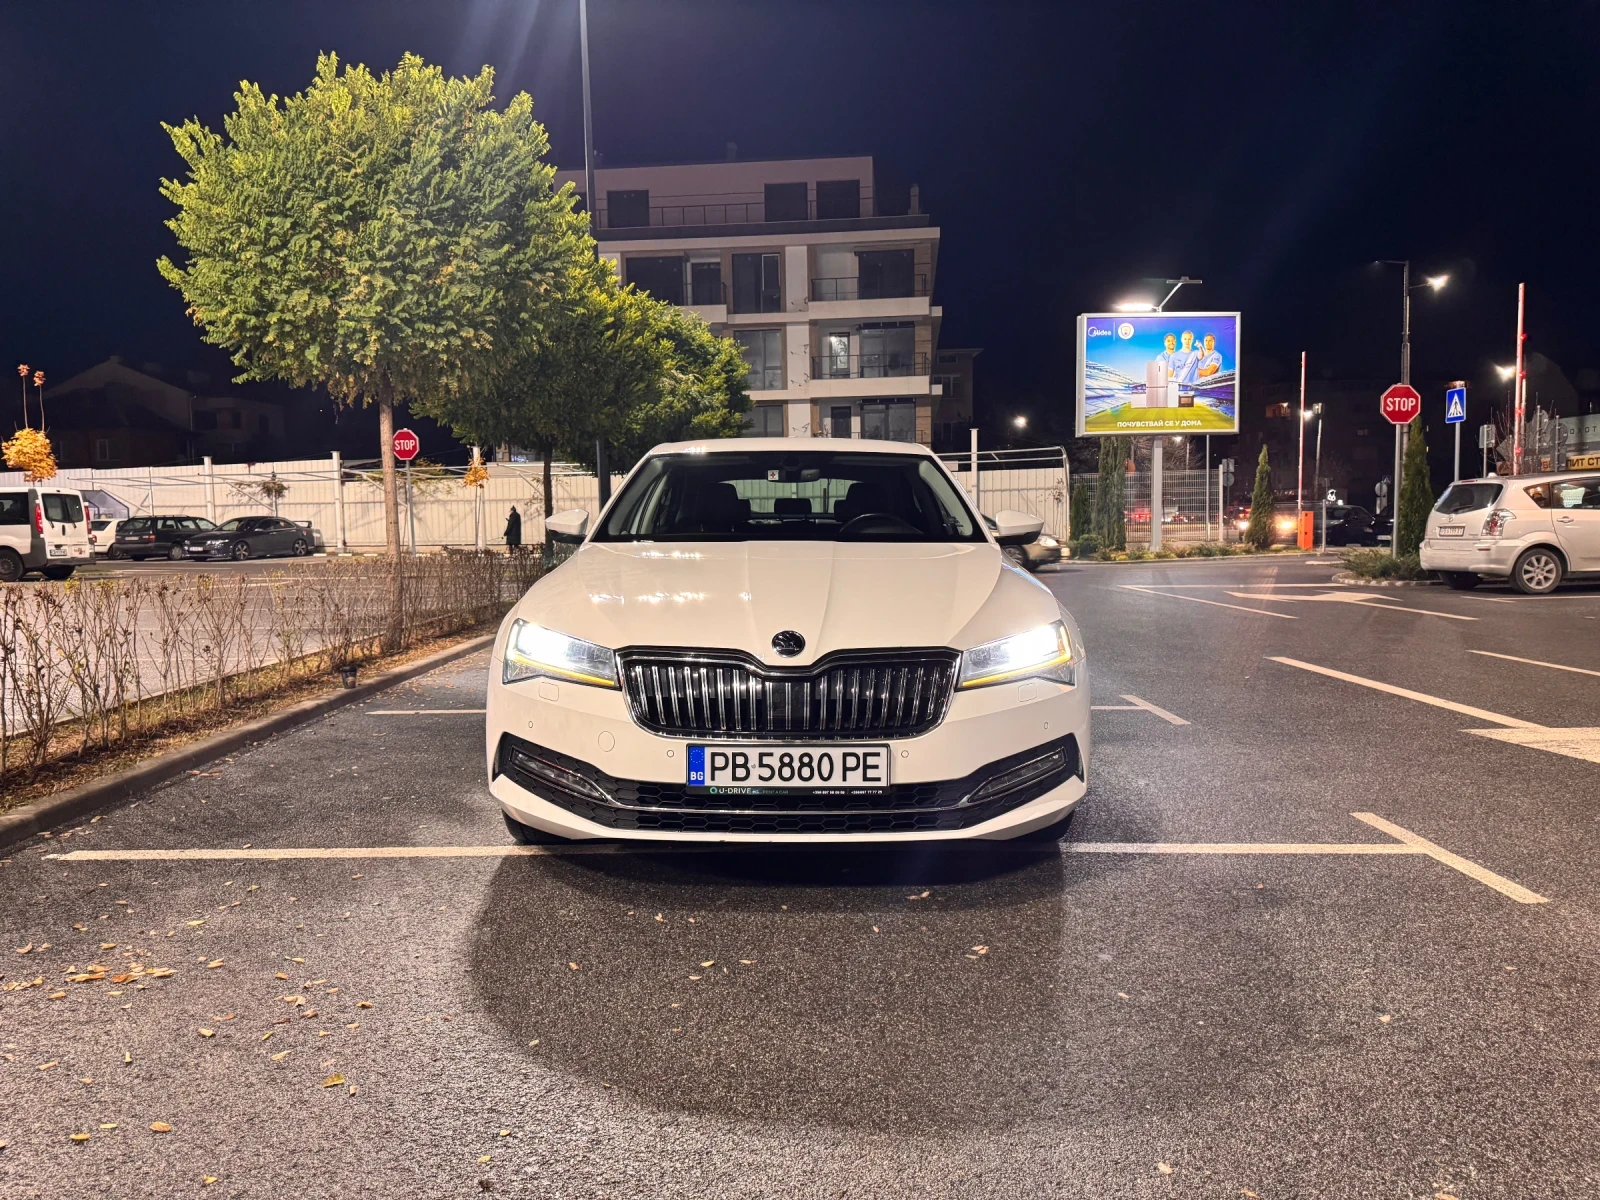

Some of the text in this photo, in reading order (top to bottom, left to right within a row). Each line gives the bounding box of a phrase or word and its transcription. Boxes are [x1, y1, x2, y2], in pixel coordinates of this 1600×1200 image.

[1088, 327, 1112, 337] Midea
[1386, 397, 1416, 412] STOP
[1117, 420, 1163, 428] ПОЧУВСТВАЙ
[394, 440, 415, 451] STOP
[710, 752, 882, 781] PB 5880 PE
[690, 771, 704, 781] BG
